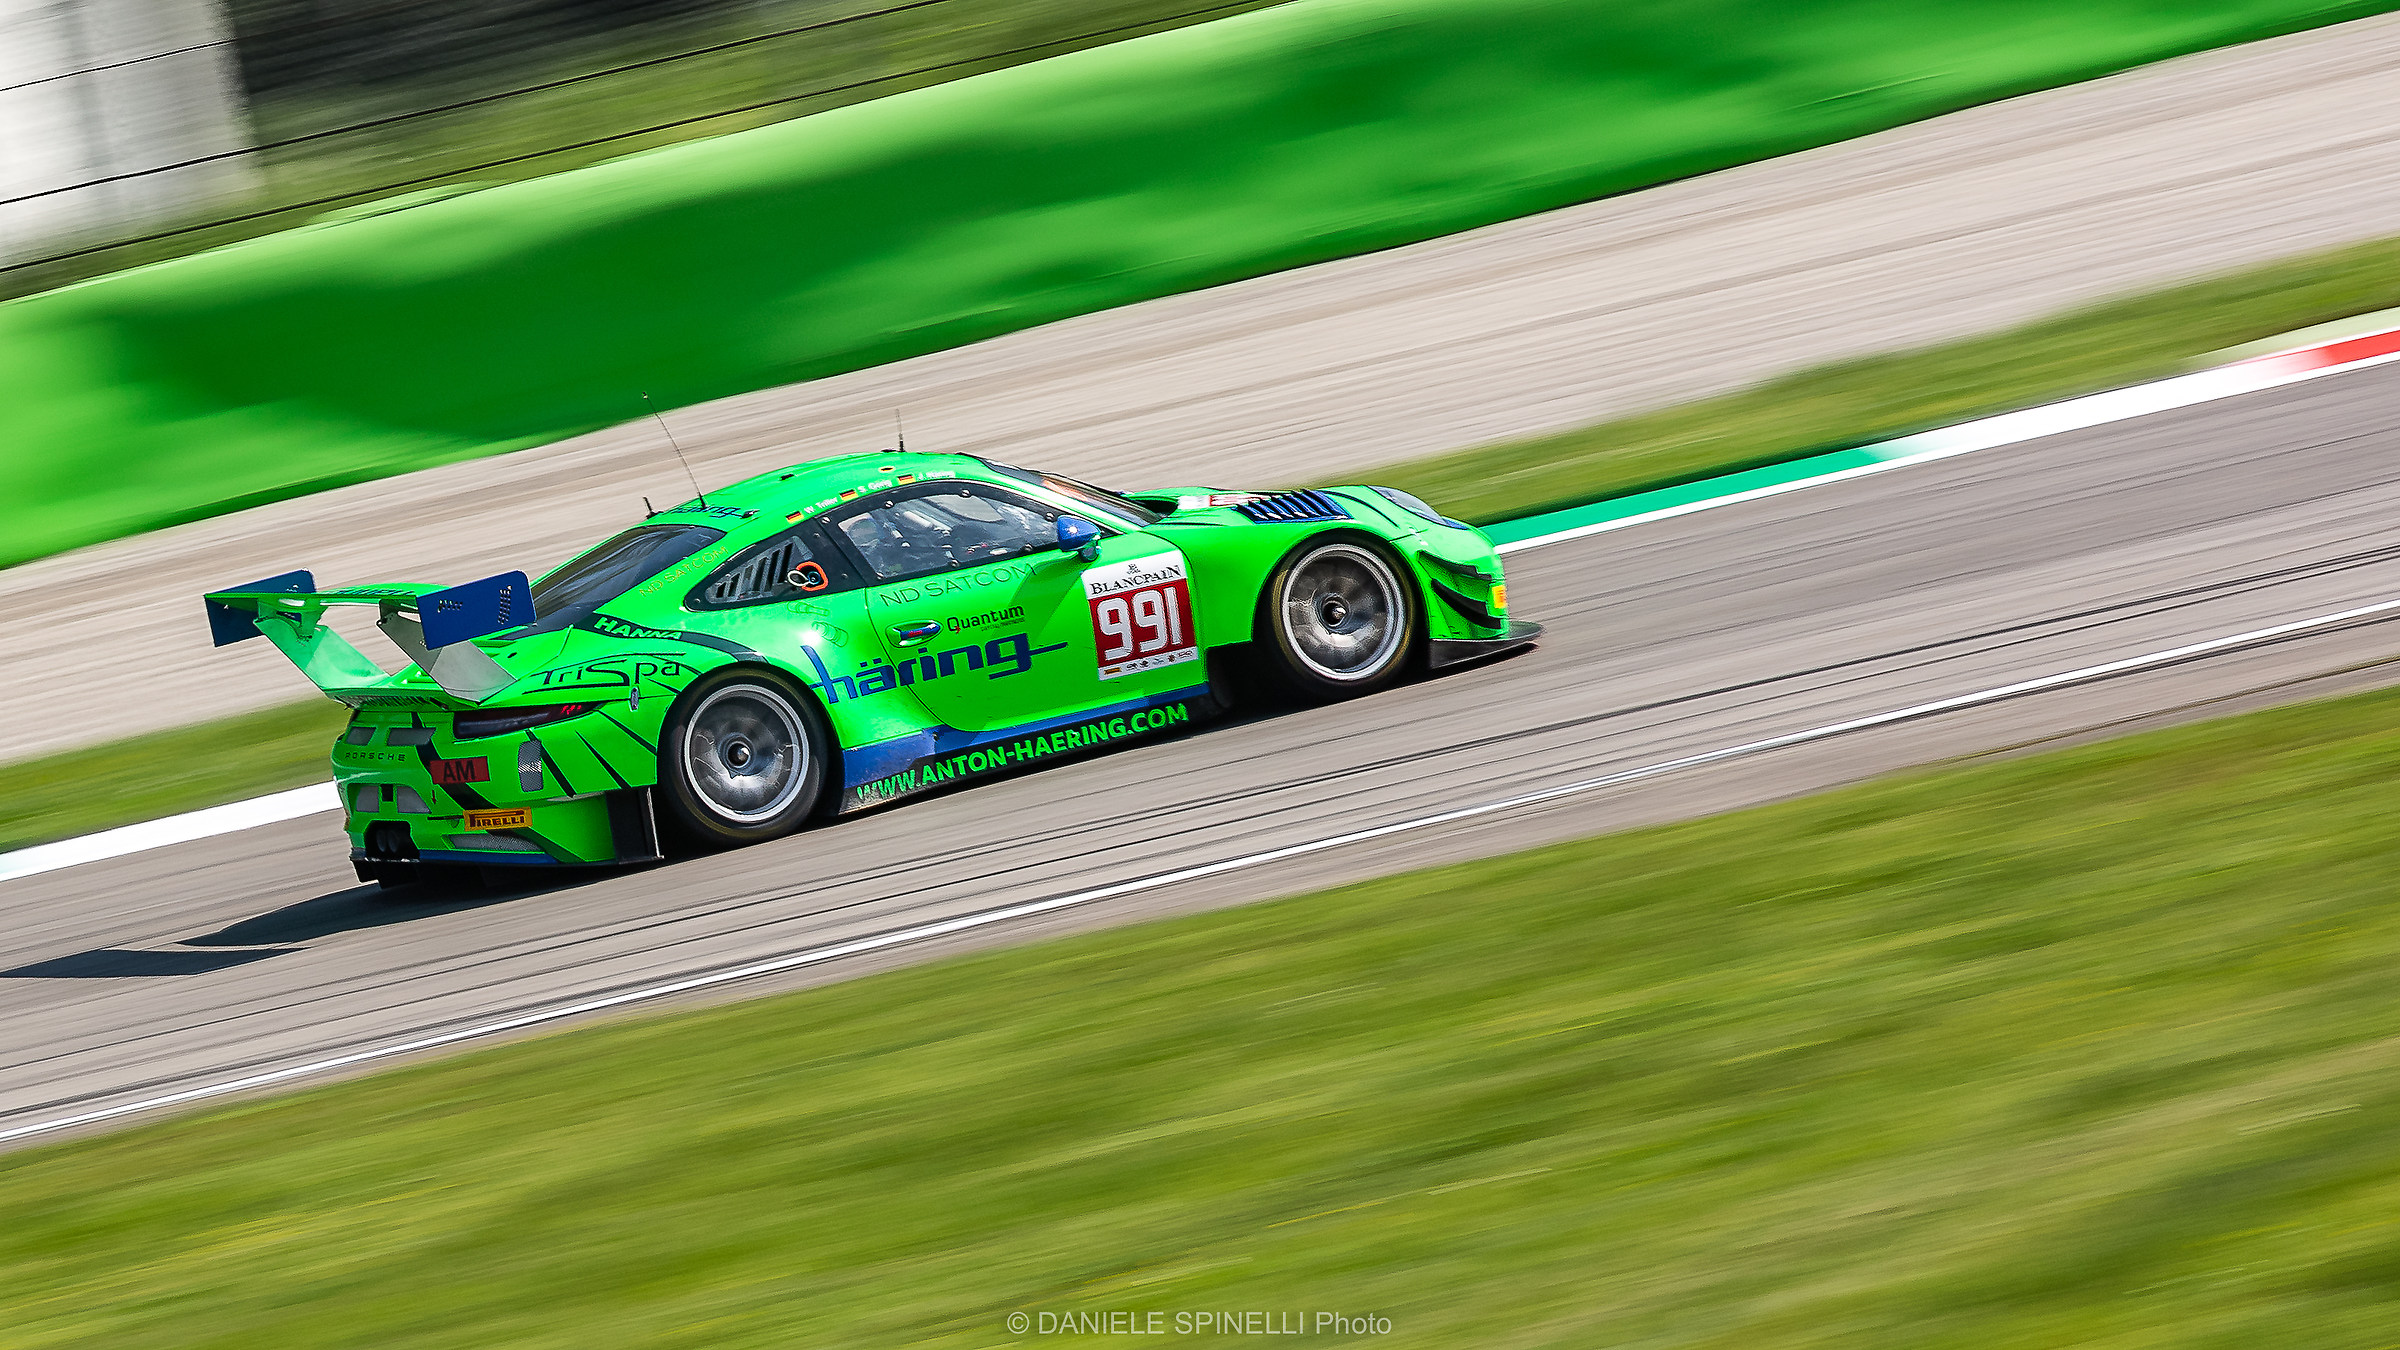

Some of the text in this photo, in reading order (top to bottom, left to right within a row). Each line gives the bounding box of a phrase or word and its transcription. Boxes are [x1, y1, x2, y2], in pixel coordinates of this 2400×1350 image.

[639, 545, 729, 598] ND SATCOM
[879, 562, 1038, 607] ND SATCOM
[1090, 564, 1182, 595] BLANCPAIN
[593, 616, 682, 640] HANNA
[946, 604, 1025, 634] Quantum
[1096, 586, 1183, 661] 991
[522, 652, 687, 695] TriSpa
[801, 631, 1068, 704] häring
[344, 751, 407, 762] PORSCHE
[856, 702, 1190, 800] WWW.ANTON-HAERING.COM
[442, 759, 476, 782] AM
[468, 809, 526, 828] PIRELLI
